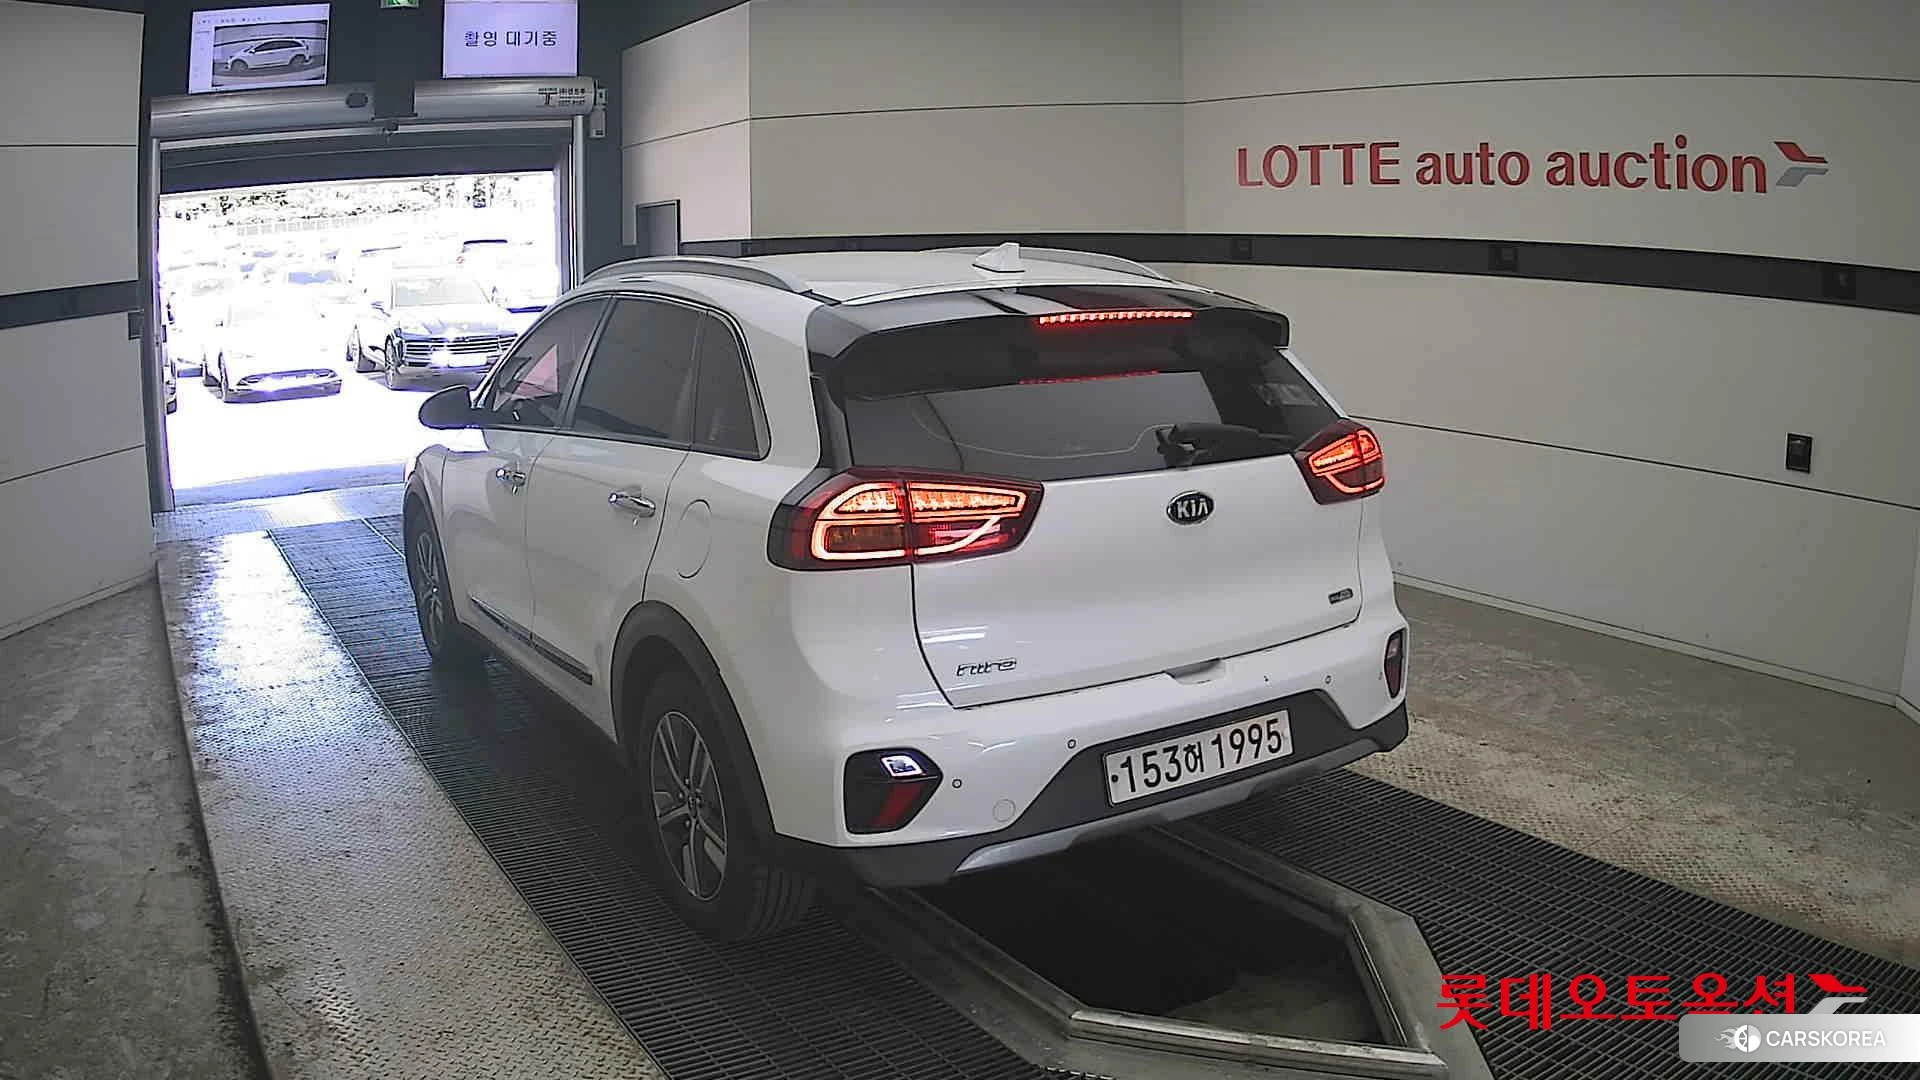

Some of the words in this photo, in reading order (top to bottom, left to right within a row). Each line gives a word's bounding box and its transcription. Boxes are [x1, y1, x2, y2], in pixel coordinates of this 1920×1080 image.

[505, 30, 558, 47] 대기중
[1236, 142, 1400, 188] LOTTE
[1416, 142, 1531, 186] auto
[1546, 134, 1767, 194] auction
[1176, 498, 1209, 519] KIA
[1120, 741, 1204, 793] 153허
[1211, 718, 1282, 769] 1995
